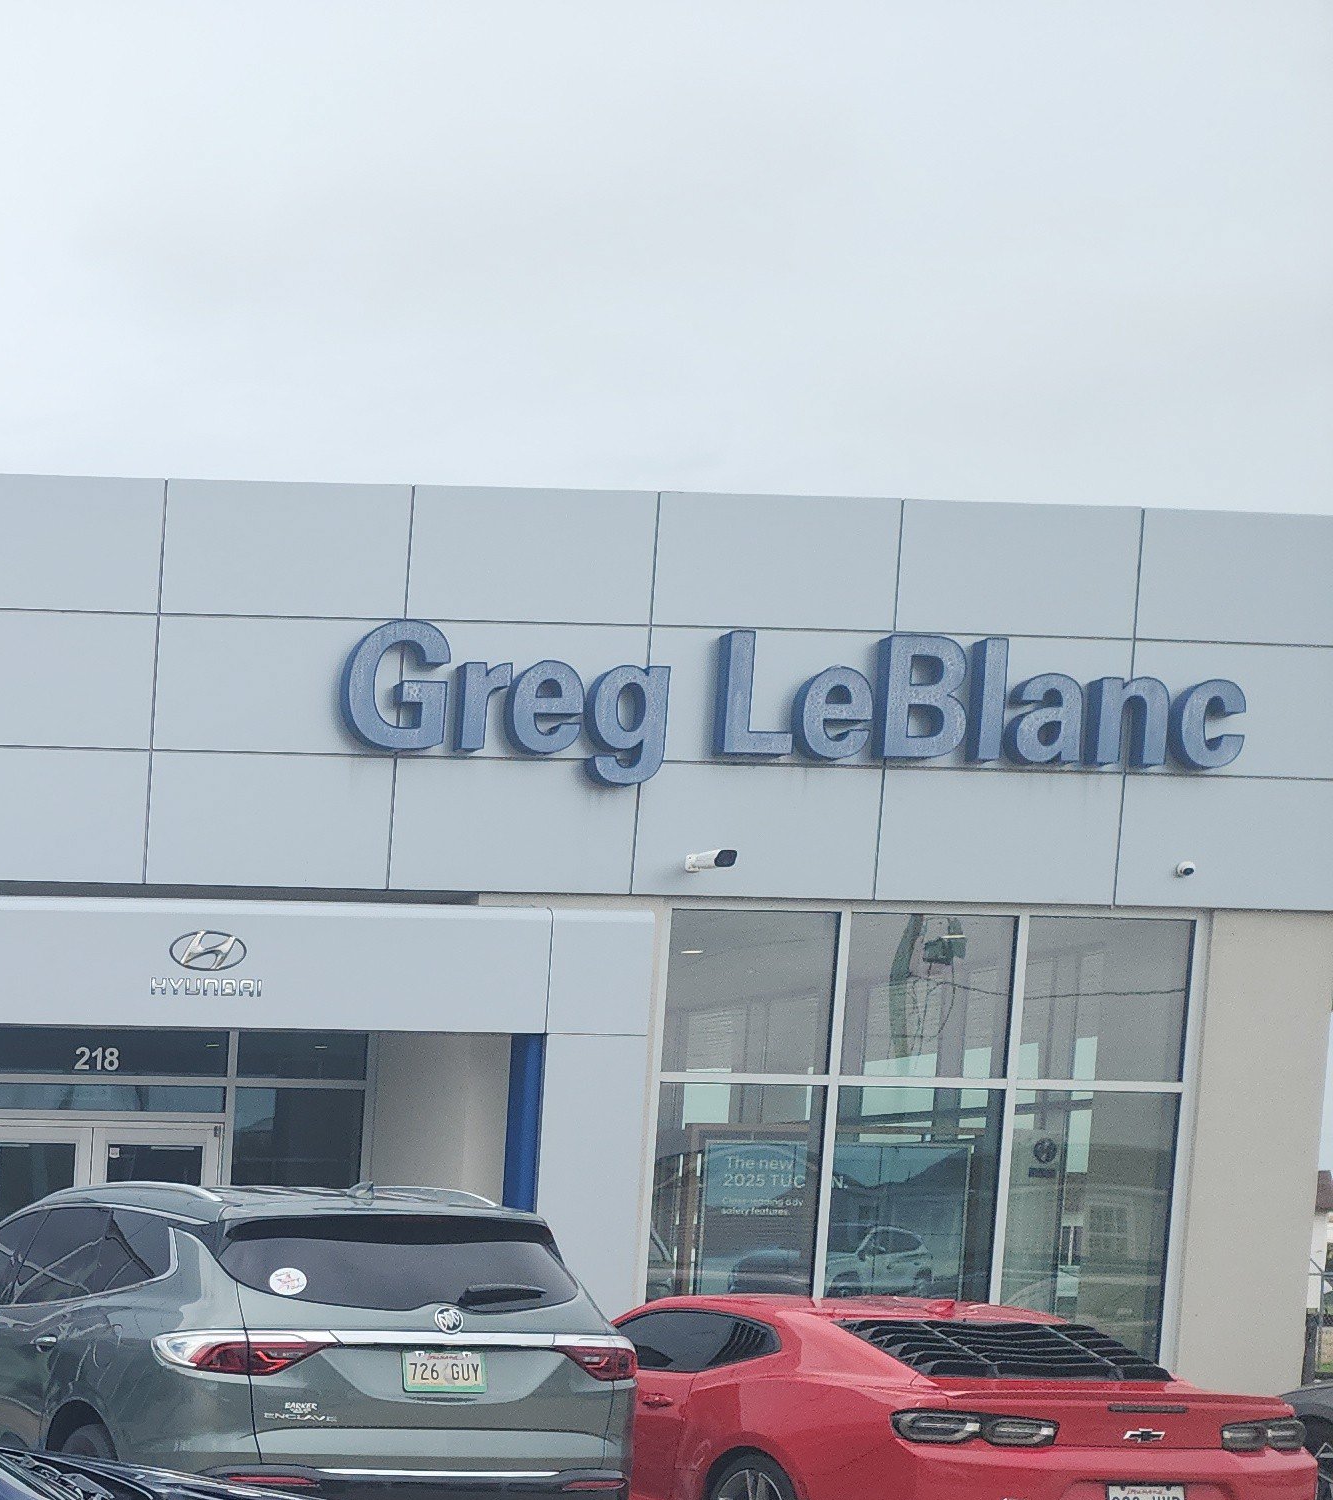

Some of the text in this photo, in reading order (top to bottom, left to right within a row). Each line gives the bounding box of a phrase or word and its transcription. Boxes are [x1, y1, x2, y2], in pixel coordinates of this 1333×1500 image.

[340, 617, 1249, 787] Greg LeBlanc
[149, 976, 263, 998] HYUNDAI
[73, 1046, 120, 1072] 218
[727, 1155, 795, 1172] The new
[722, 1173, 849, 1190] 2025 TUCN.
[409, 1362, 480, 1381] 726 GUY
[263, 1411, 339, 1423] ENCLAVE
